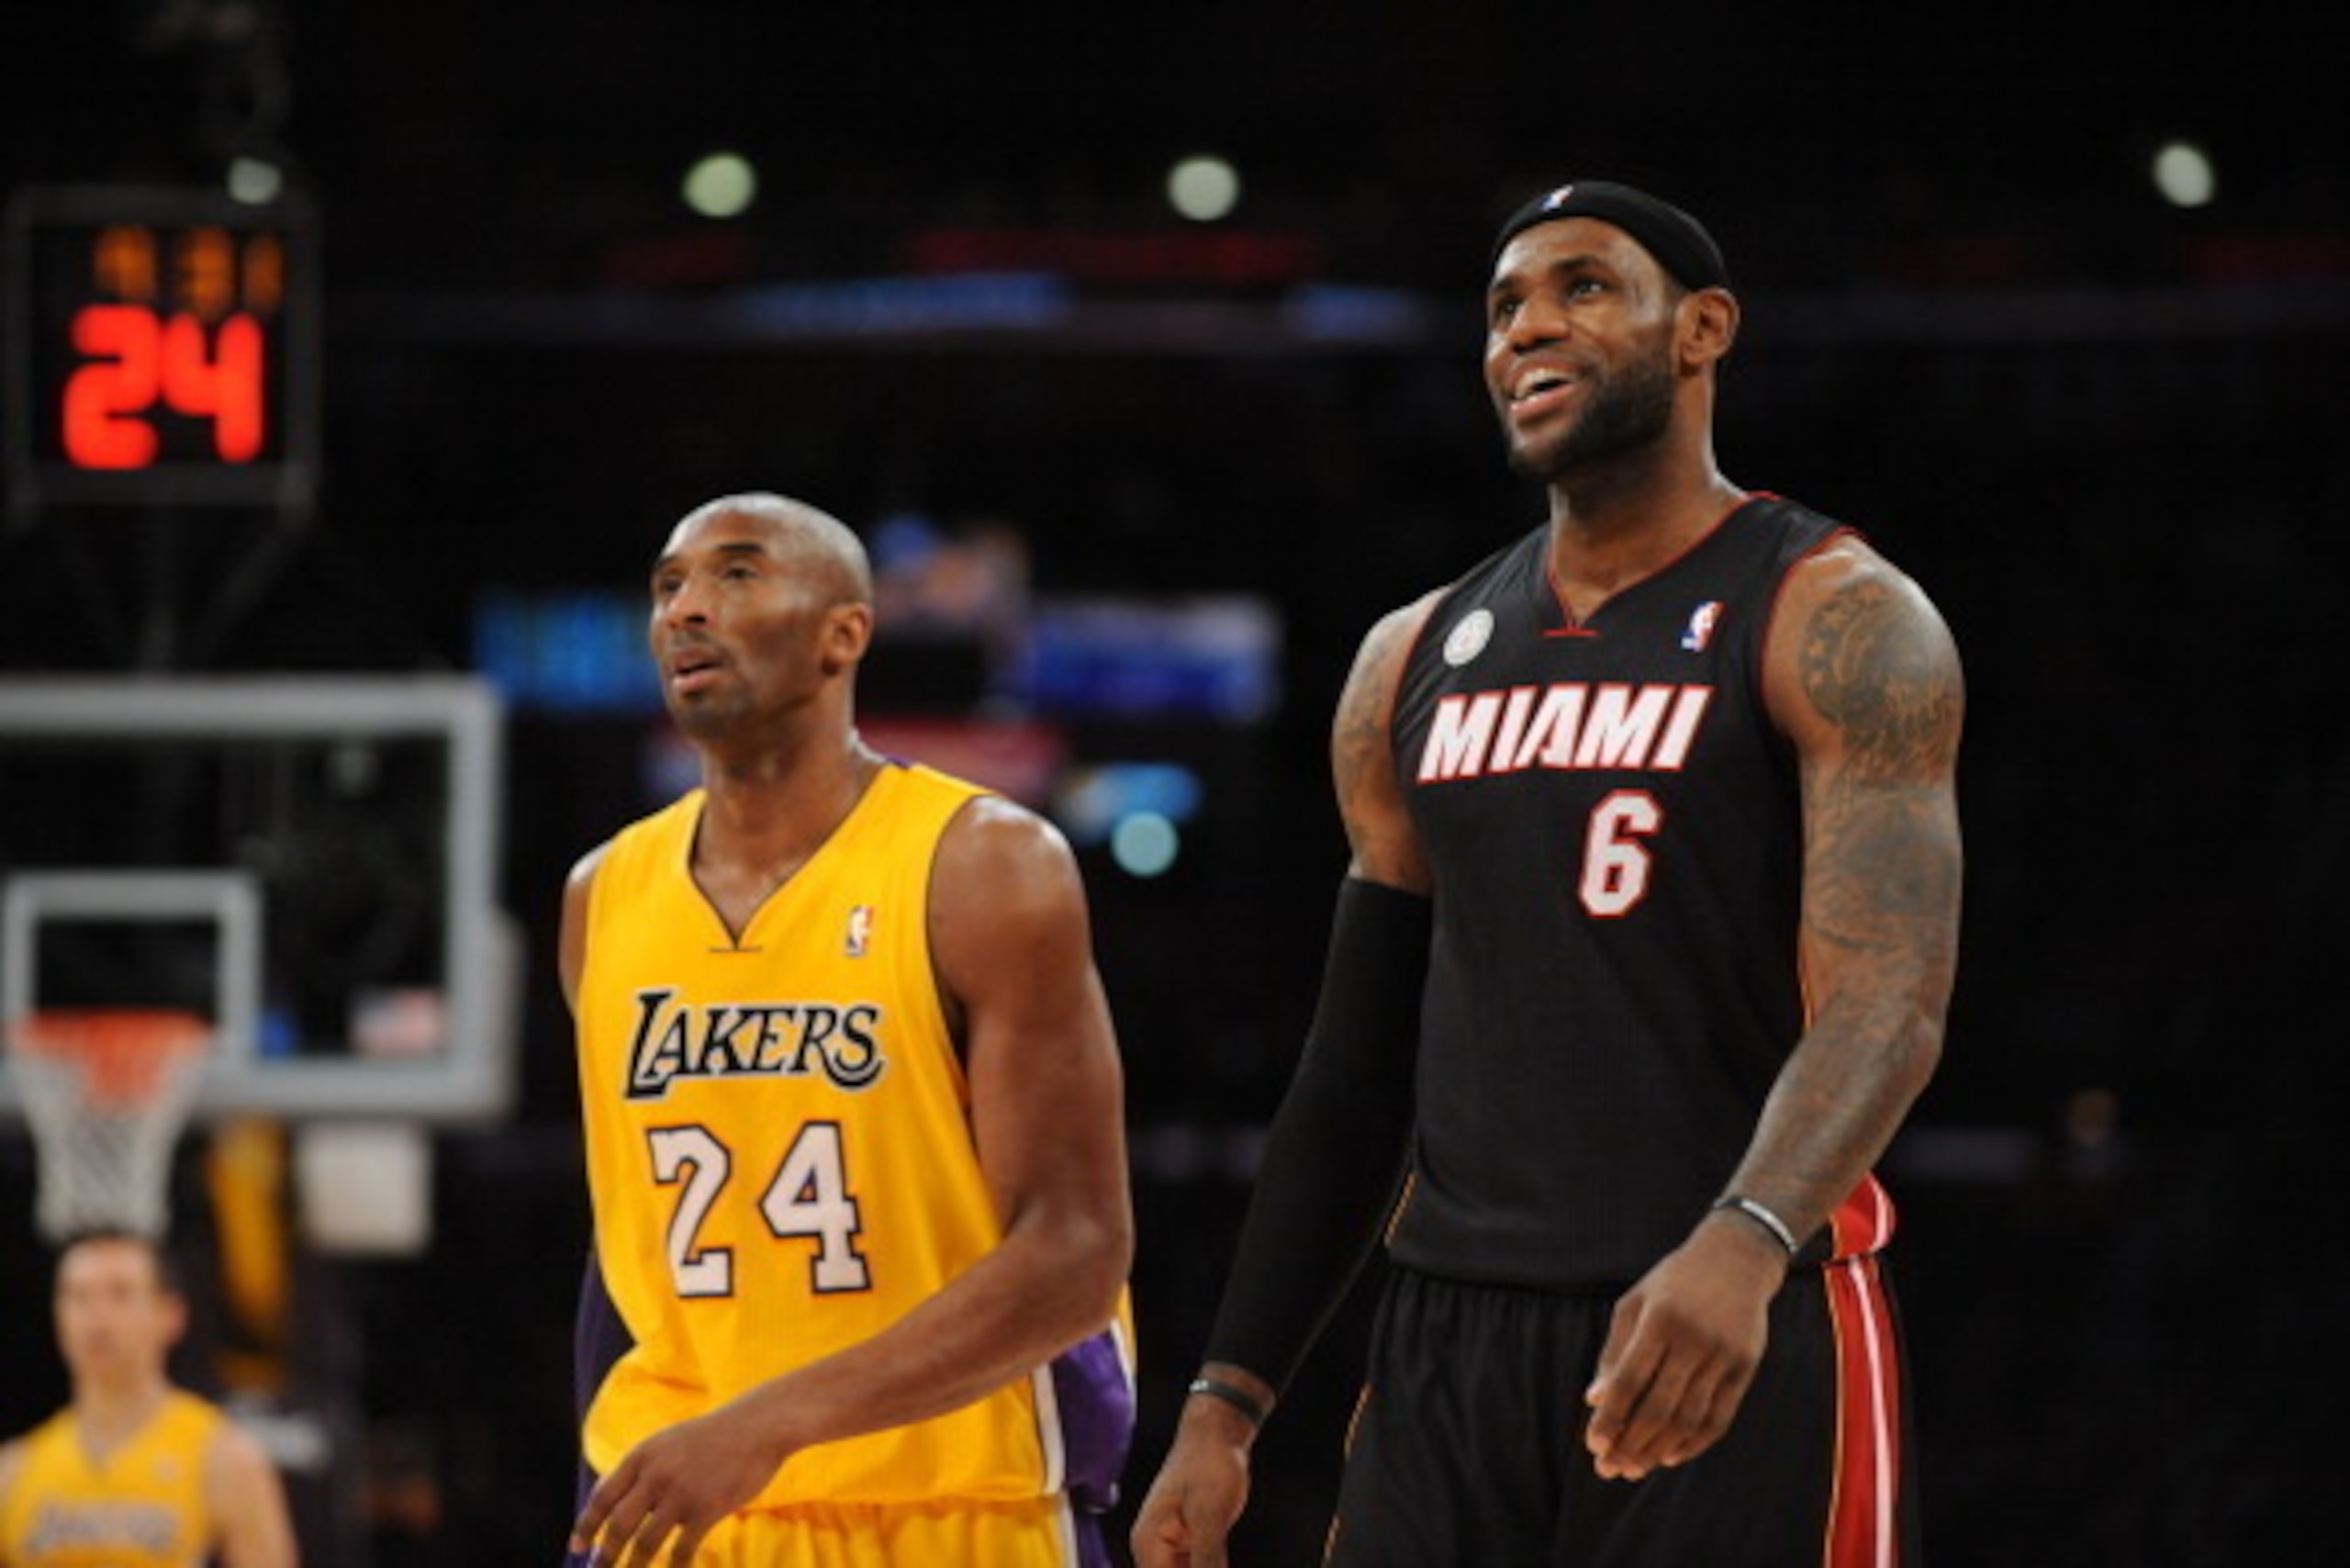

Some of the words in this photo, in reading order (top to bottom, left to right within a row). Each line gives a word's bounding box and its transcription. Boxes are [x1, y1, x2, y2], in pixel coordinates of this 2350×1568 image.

[62, 304, 265, 469] 24
[1416, 682, 1716, 784] MIAMI
[1578, 788, 1663, 917] 6
[624, 989, 886, 1100] LAKERS
[645, 1120, 871, 1298] 24
